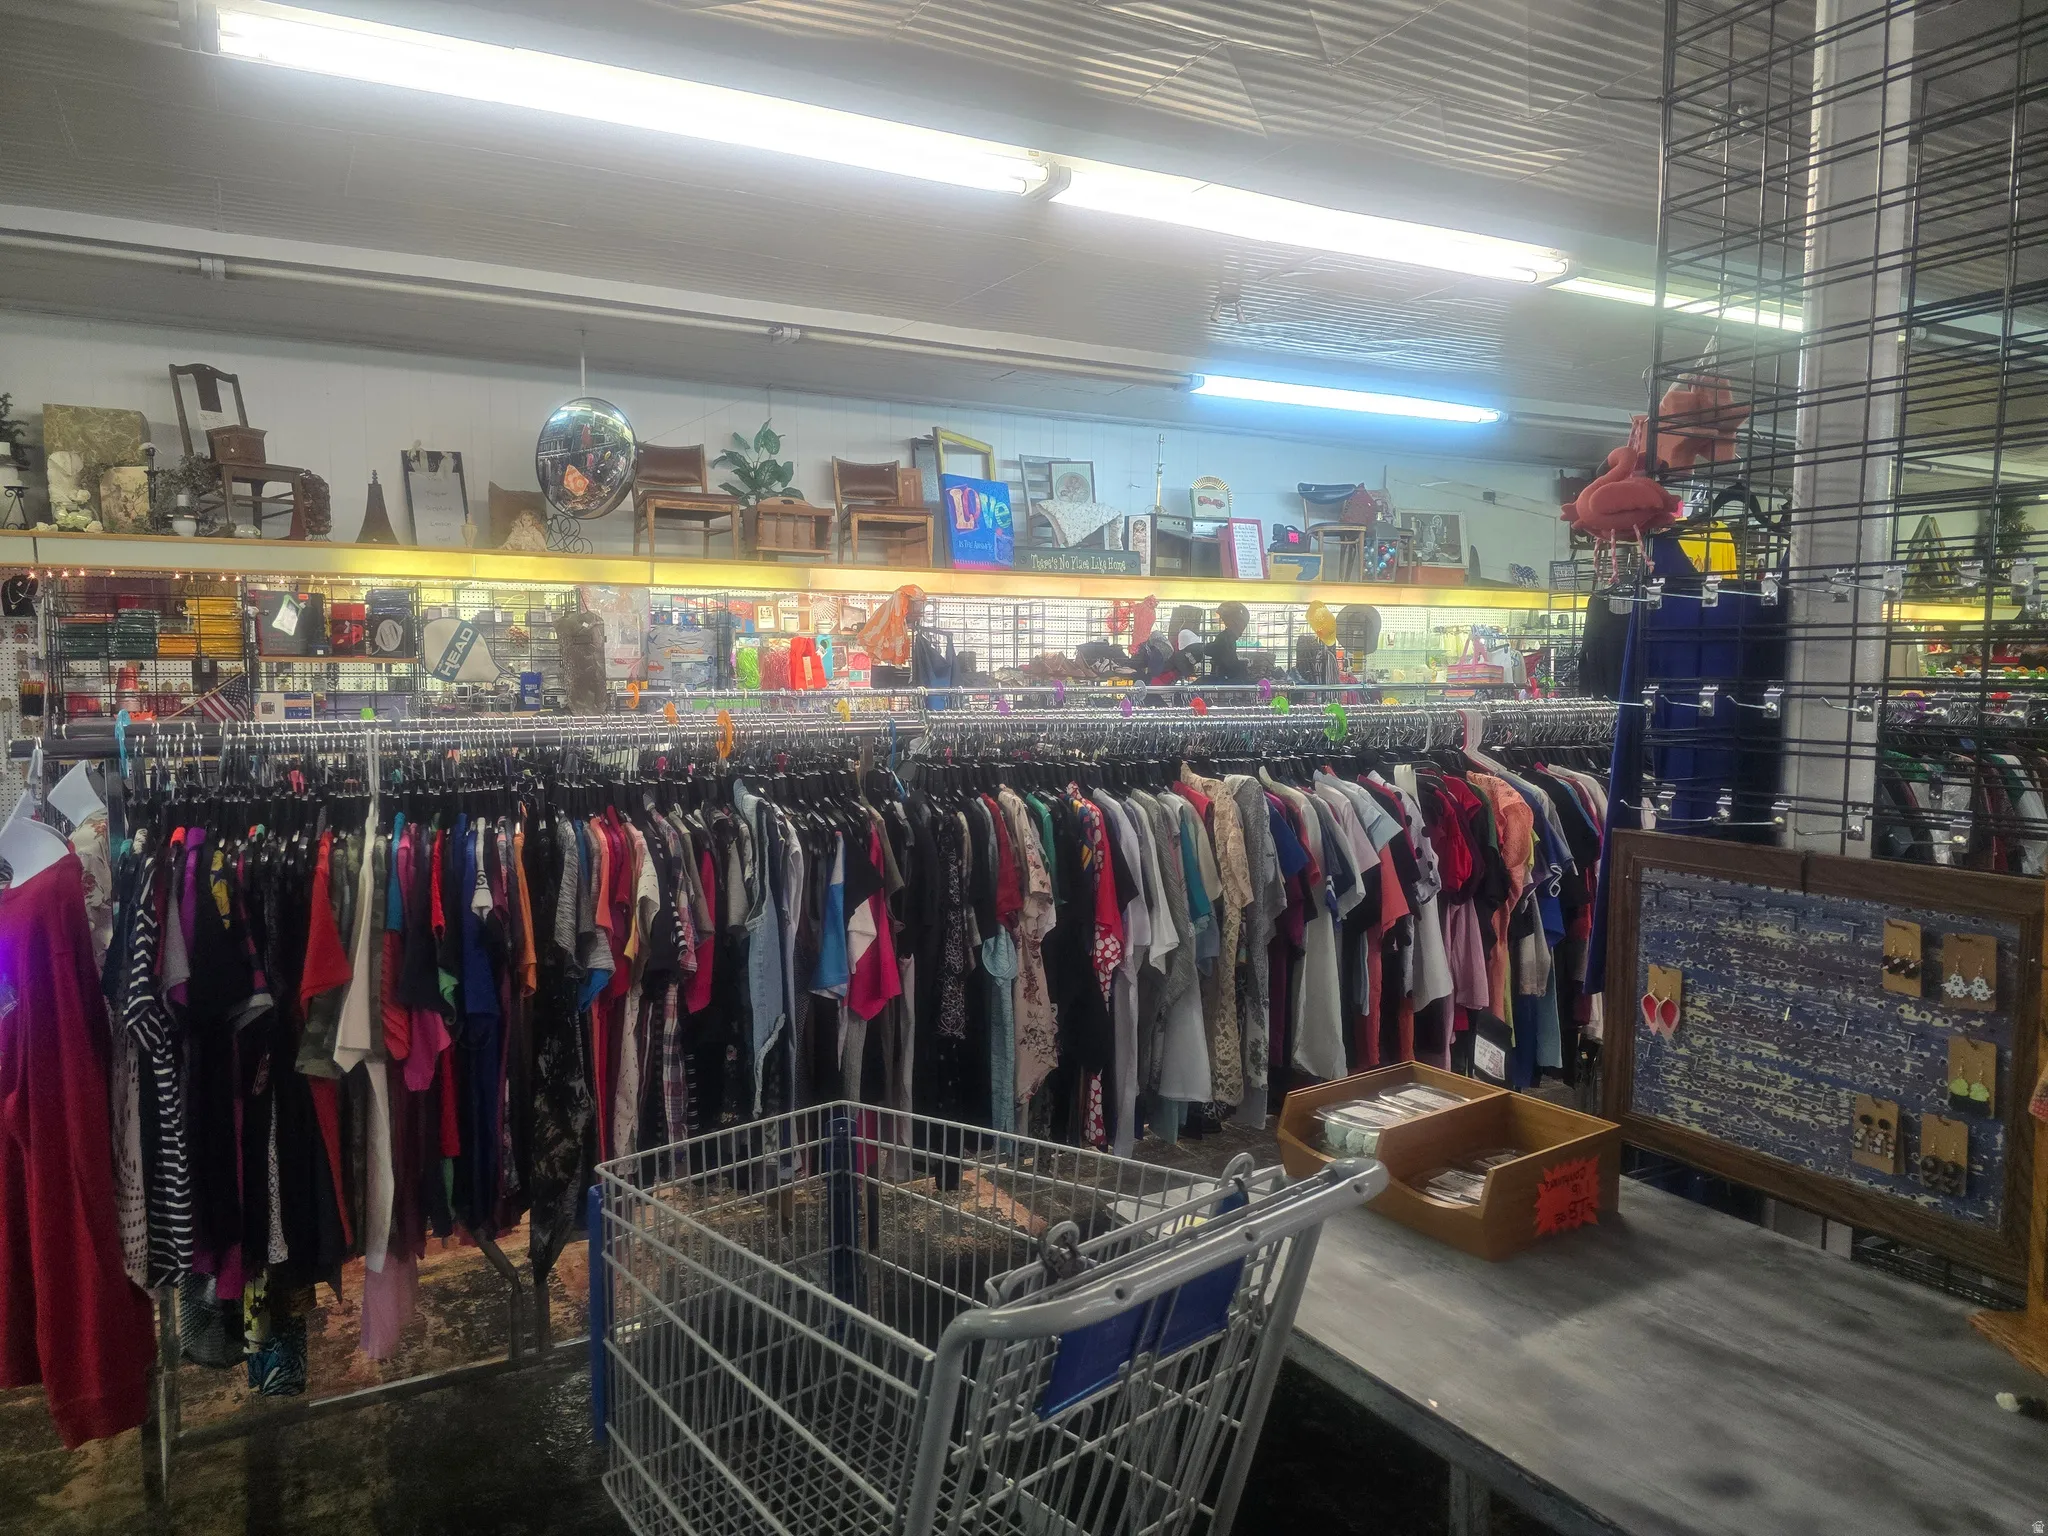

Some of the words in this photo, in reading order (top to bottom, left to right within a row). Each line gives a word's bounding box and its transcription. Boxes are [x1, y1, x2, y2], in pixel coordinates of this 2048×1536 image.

[1030, 553, 1058, 571] There's
[1059, 554, 1070, 570] No
[1071, 555, 1090, 570] Place
[1091, 556, 1107, 574] Like
[1108, 557, 1126, 572] Home
[440, 628, 474, 677] HEAD
